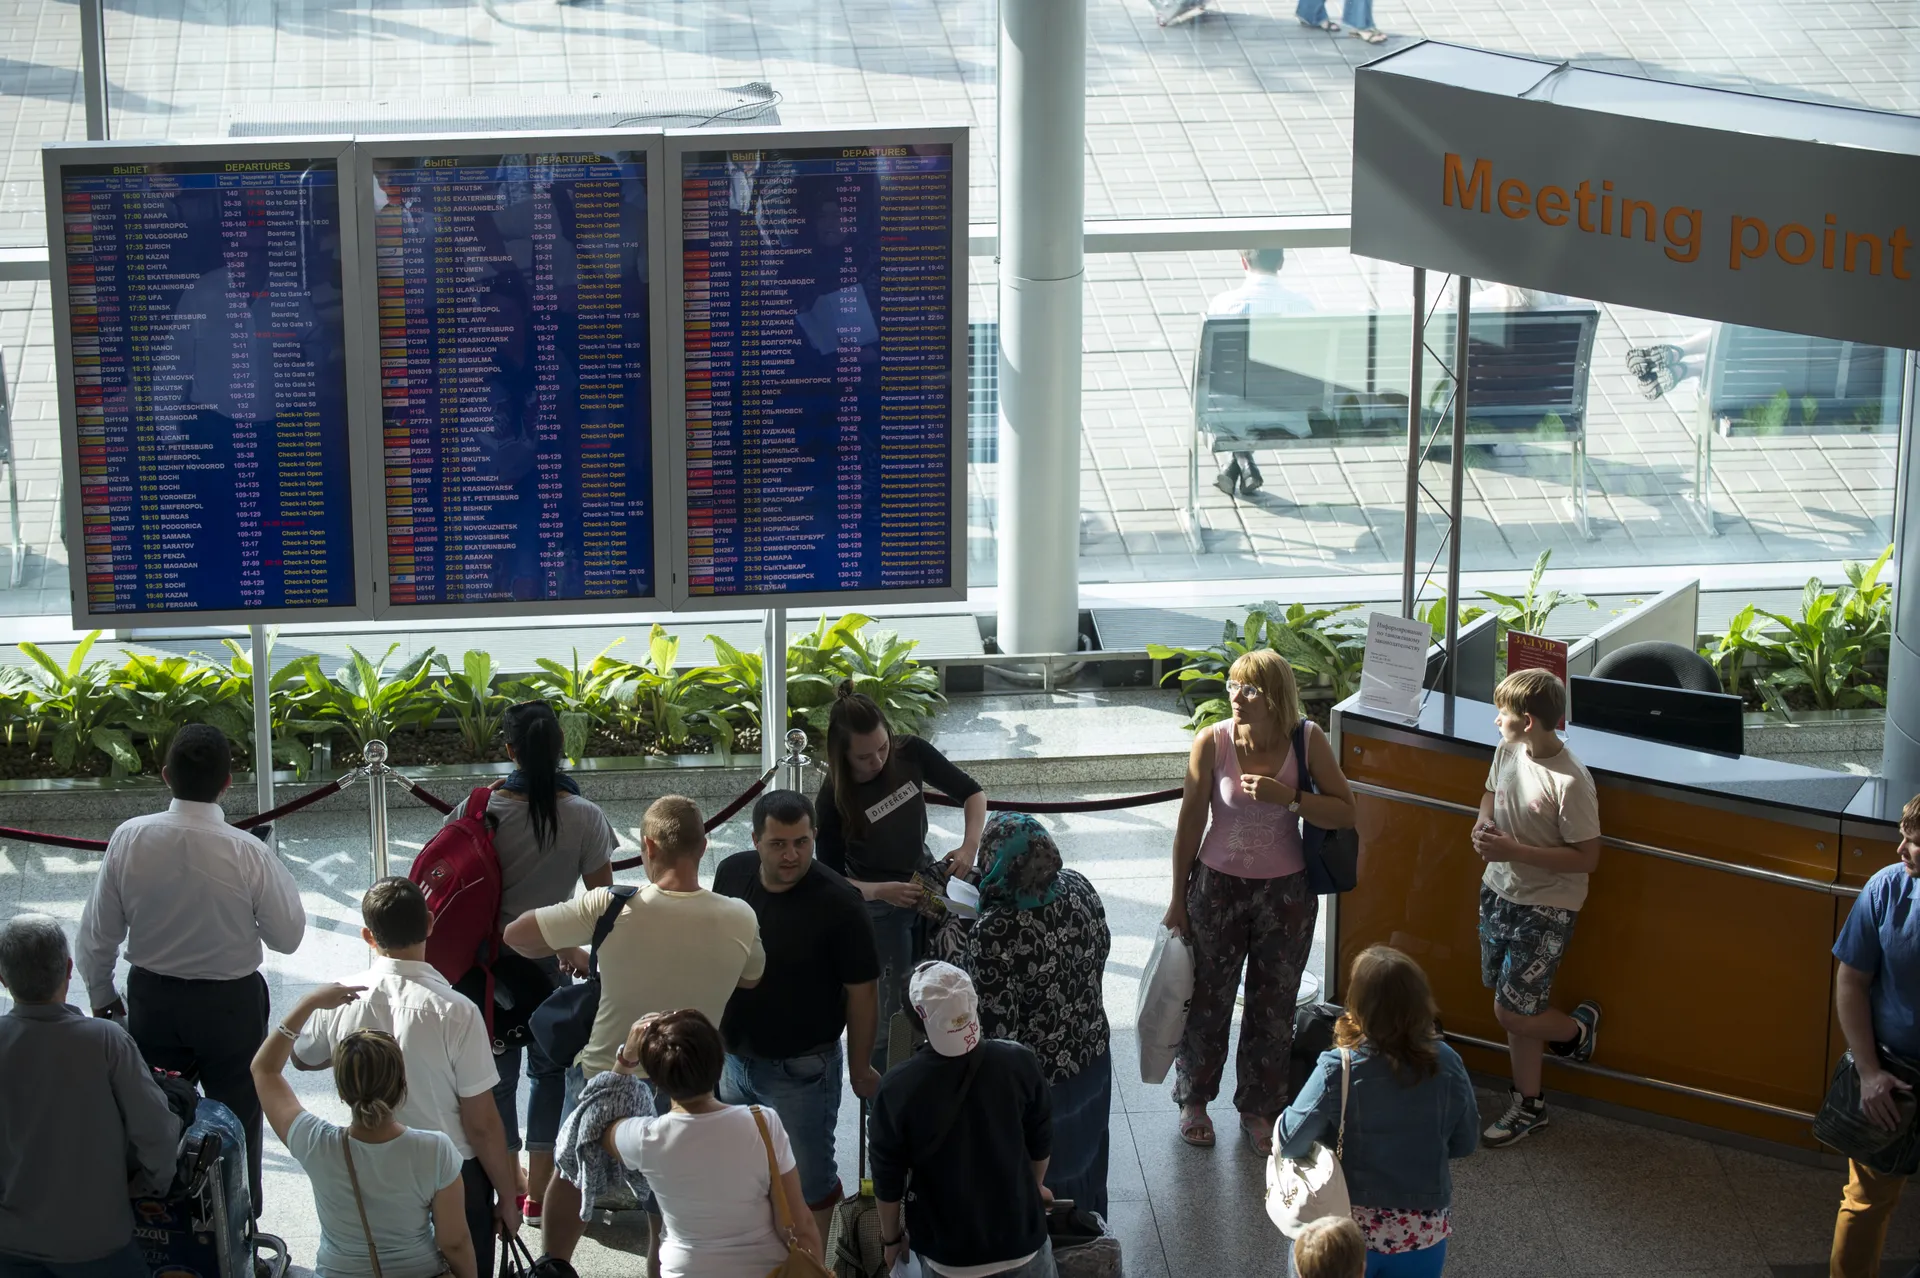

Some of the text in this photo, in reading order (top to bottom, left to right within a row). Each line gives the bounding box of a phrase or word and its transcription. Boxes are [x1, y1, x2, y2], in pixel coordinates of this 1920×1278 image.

[732, 152, 766, 160] ВЫЛЕТ
[842, 148, 906, 157] DEPARTURES
[424, 158, 458, 166] ВЫЛЕТ
[536, 155, 600, 164] DEPARTURES
[225, 162, 290, 171] DEPARTURES
[452, 194, 506, 202] EKATERINBURG
[452, 204, 504, 212] ARKHANGELSK
[1443, 152, 1912, 279] Meeting point
[267, 229, 295, 238] Boarding
[759, 248, 812, 256] НОВОСИБИРСК
[146, 273, 200, 281] EKATERINBURG
[760, 278, 815, 286] ПЕТРОЗАВОДСК
[146, 283, 194, 291] KALININGRAD
[881, 304, 919, 313] Регистрация
[469, 325, 514, 333] PETERSBURG
[457, 335, 509, 344] KRASNOYARSK
[761, 377, 831, 386] УСТЬ-КАМЕНОГОРСК
[154, 404, 218, 412] BLAGOVESCHENSK
[761, 456, 815, 464] СИМФЕРОПОЛЬ
[306, 470, 322, 478] Open
[462, 484, 513, 492] KRASNOYARSK
[762, 485, 814, 493] ЕКАТЕРИНБУРГ
[762, 514, 813, 522] НОВОСИБИРСК
[463, 523, 517, 531] NOVOKUZNETSK
[762, 533, 825, 542] САНКТ-ПЕТЕРБУРГ
[464, 542, 516, 551] EKATERINBURG
[762, 543, 815, 552] СИМФЕРОПОЛЬ
[310, 558, 326, 566] Open
[762, 563, 806, 571] СЫКТЫВКАР
[763, 572, 814, 580] НОВОСИБИРСК
[1514, 635, 1556, 651] ЗАЛ VIP
[871, 786, 913, 817] DIFFERENT
